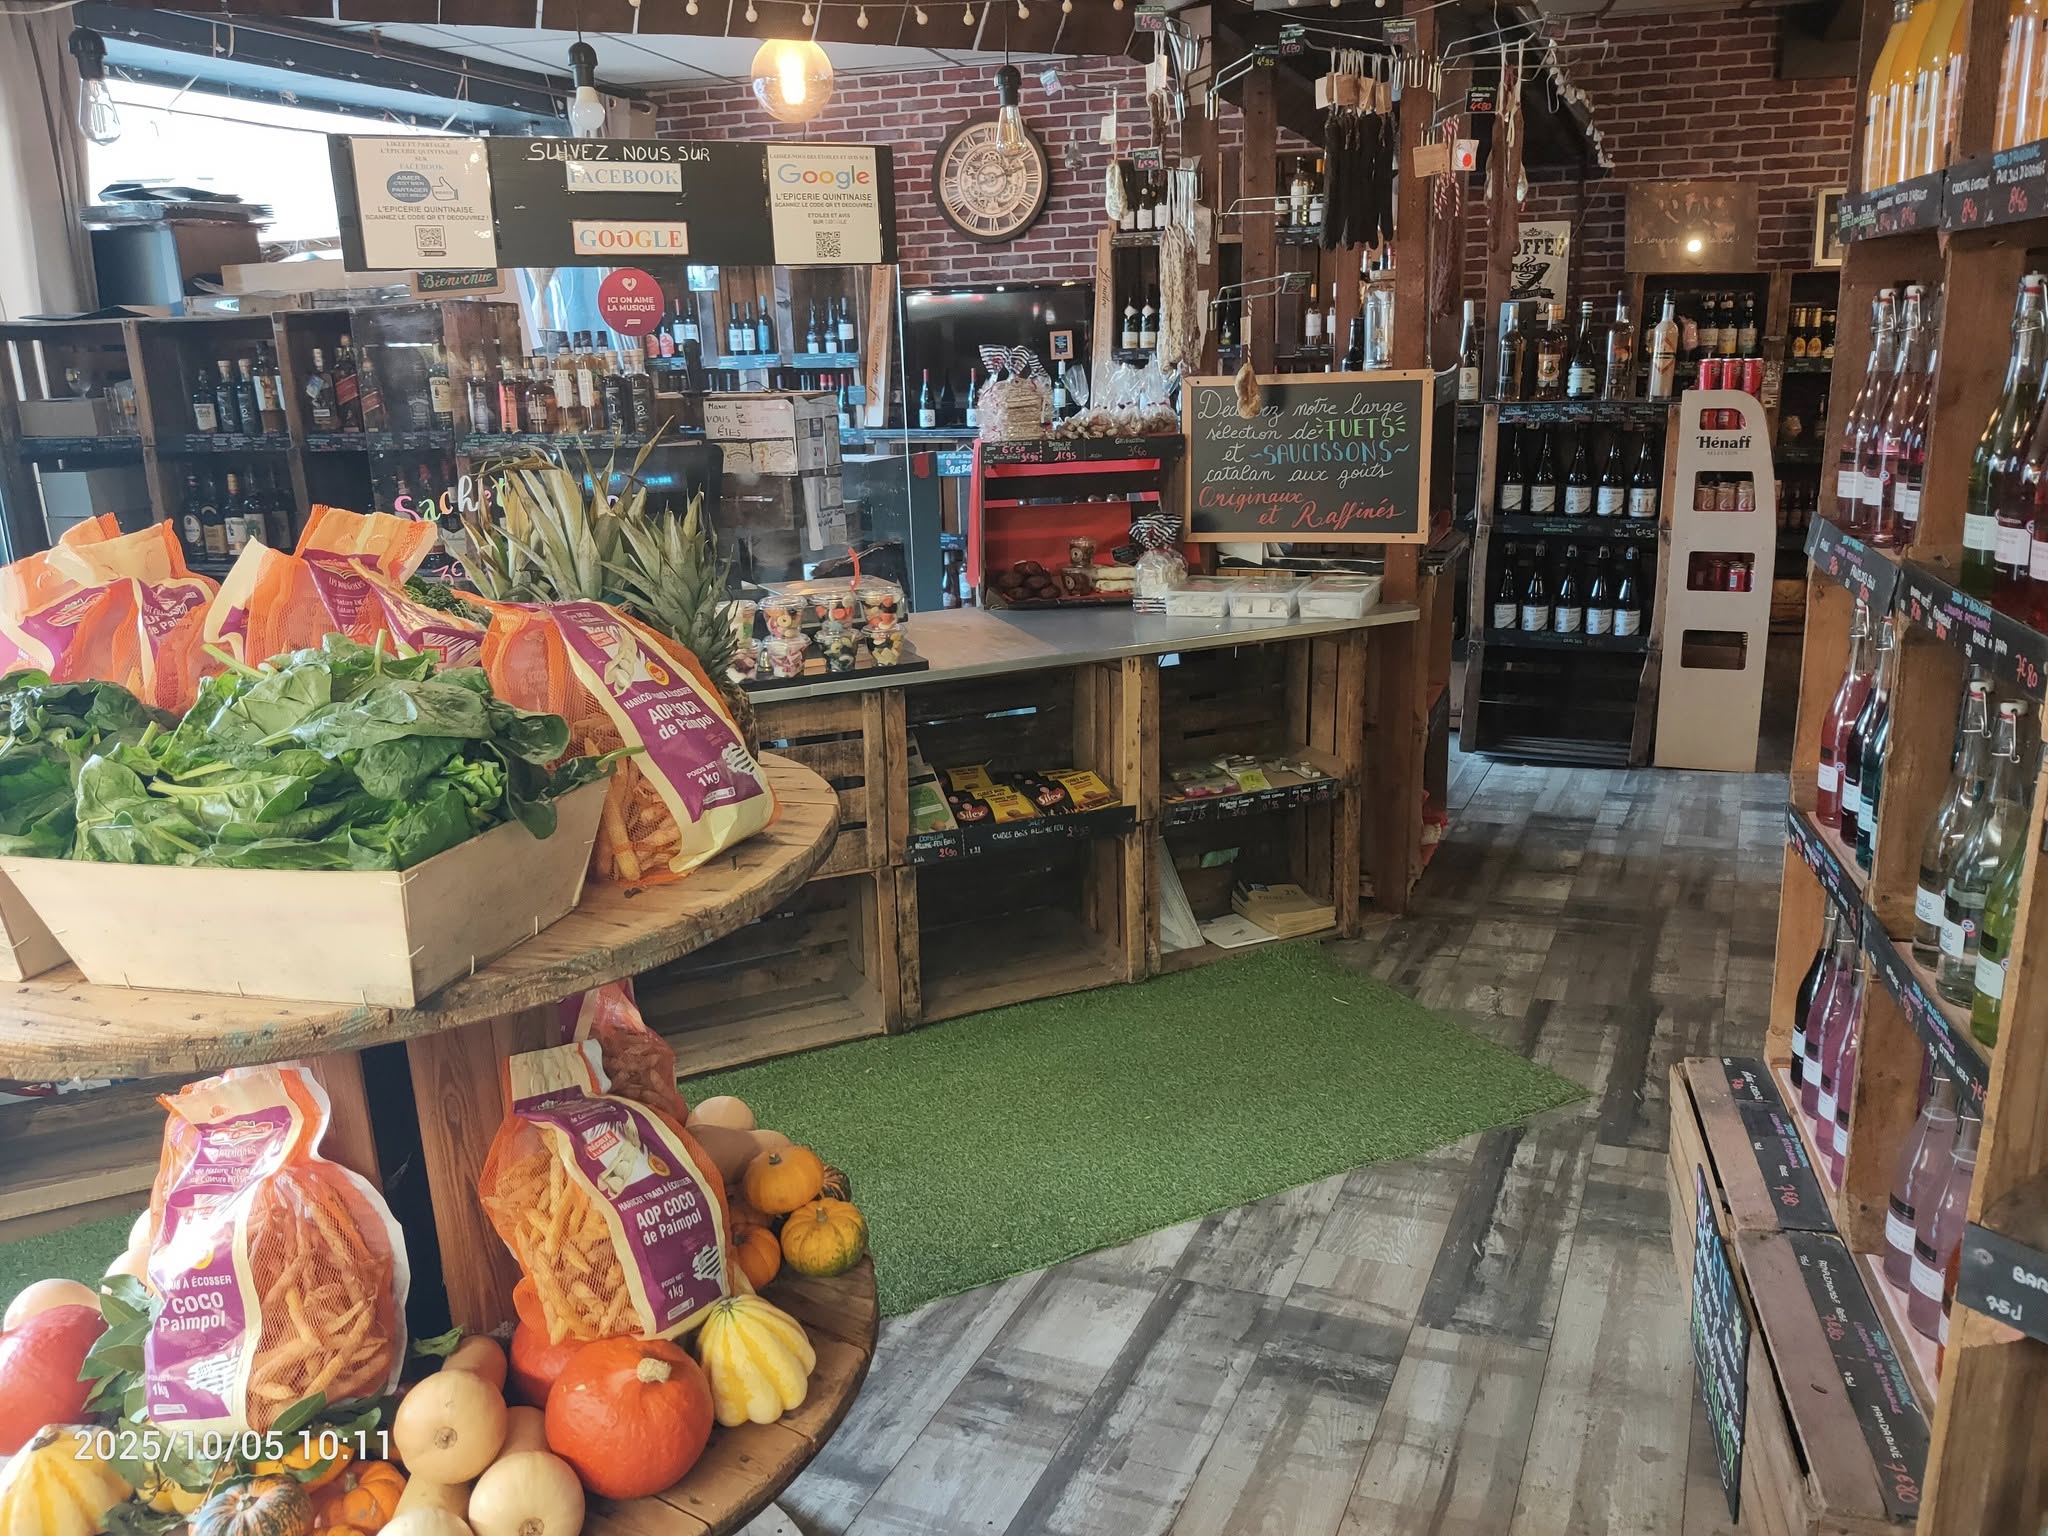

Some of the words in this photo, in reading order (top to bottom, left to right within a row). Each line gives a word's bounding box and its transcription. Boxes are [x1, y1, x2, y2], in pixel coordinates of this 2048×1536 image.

[528, 141, 609, 161] SUIVEZ
[623, 145, 672, 161] NOUS
[677, 143, 711, 161] SUR
[569, 168, 680, 185] FACEBOOK
[777, 163, 870, 190] Google
[776, 193, 820, 201] L'EPICERIE
[822, 193, 872, 201] QUINTINAISE
[579, 229, 684, 248] GOOGLE
[423, 271, 495, 289] Bienvenue
[607, 304, 617, 312] LA
[619, 304, 656, 313] MUSIQUE
[608, 296, 618, 304] ICI
[1292, 396, 1338, 416] notre
[1344, 392, 1408, 423] large
[1205, 421, 1282, 440] sélection
[1288, 421, 1320, 440] de
[1696, 435, 1752, 450] Hénaff
[1221, 442, 1247, 463] et
[1263, 440, 1394, 465] SAUCISSONS
[1202, 464, 1275, 484] catalan
[1287, 468, 1329, 481] aux
[1337, 462, 1394, 489] goûts
[1198, 486, 1306, 513] Originaux
[1257, 505, 1284, 525] et
[1290, 497, 1408, 531] Raffinés
[2015, 654, 2039, 689] 7€80
[648, 700, 676, 725] AOP
[658, 723, 679, 741] de
[1038, 791, 1063, 807] Silex
[959, 808, 986, 820] Silex
[636, 1207, 661, 1230] AOP
[664, 1191, 696, 1218] COCO
[643, 1230, 658, 1247] de
[659, 1210, 703, 1243] Paimpol
[191, 1274, 232, 1287] ÉCOSSER
[667, 1283, 684, 1300] 1kg
[171, 1291, 224, 1315] COCO
[160, 1310, 226, 1333] Paimpol
[152, 1384, 170, 1399] 1kg
[1870, 1404, 1904, 1460] MANDARINE
